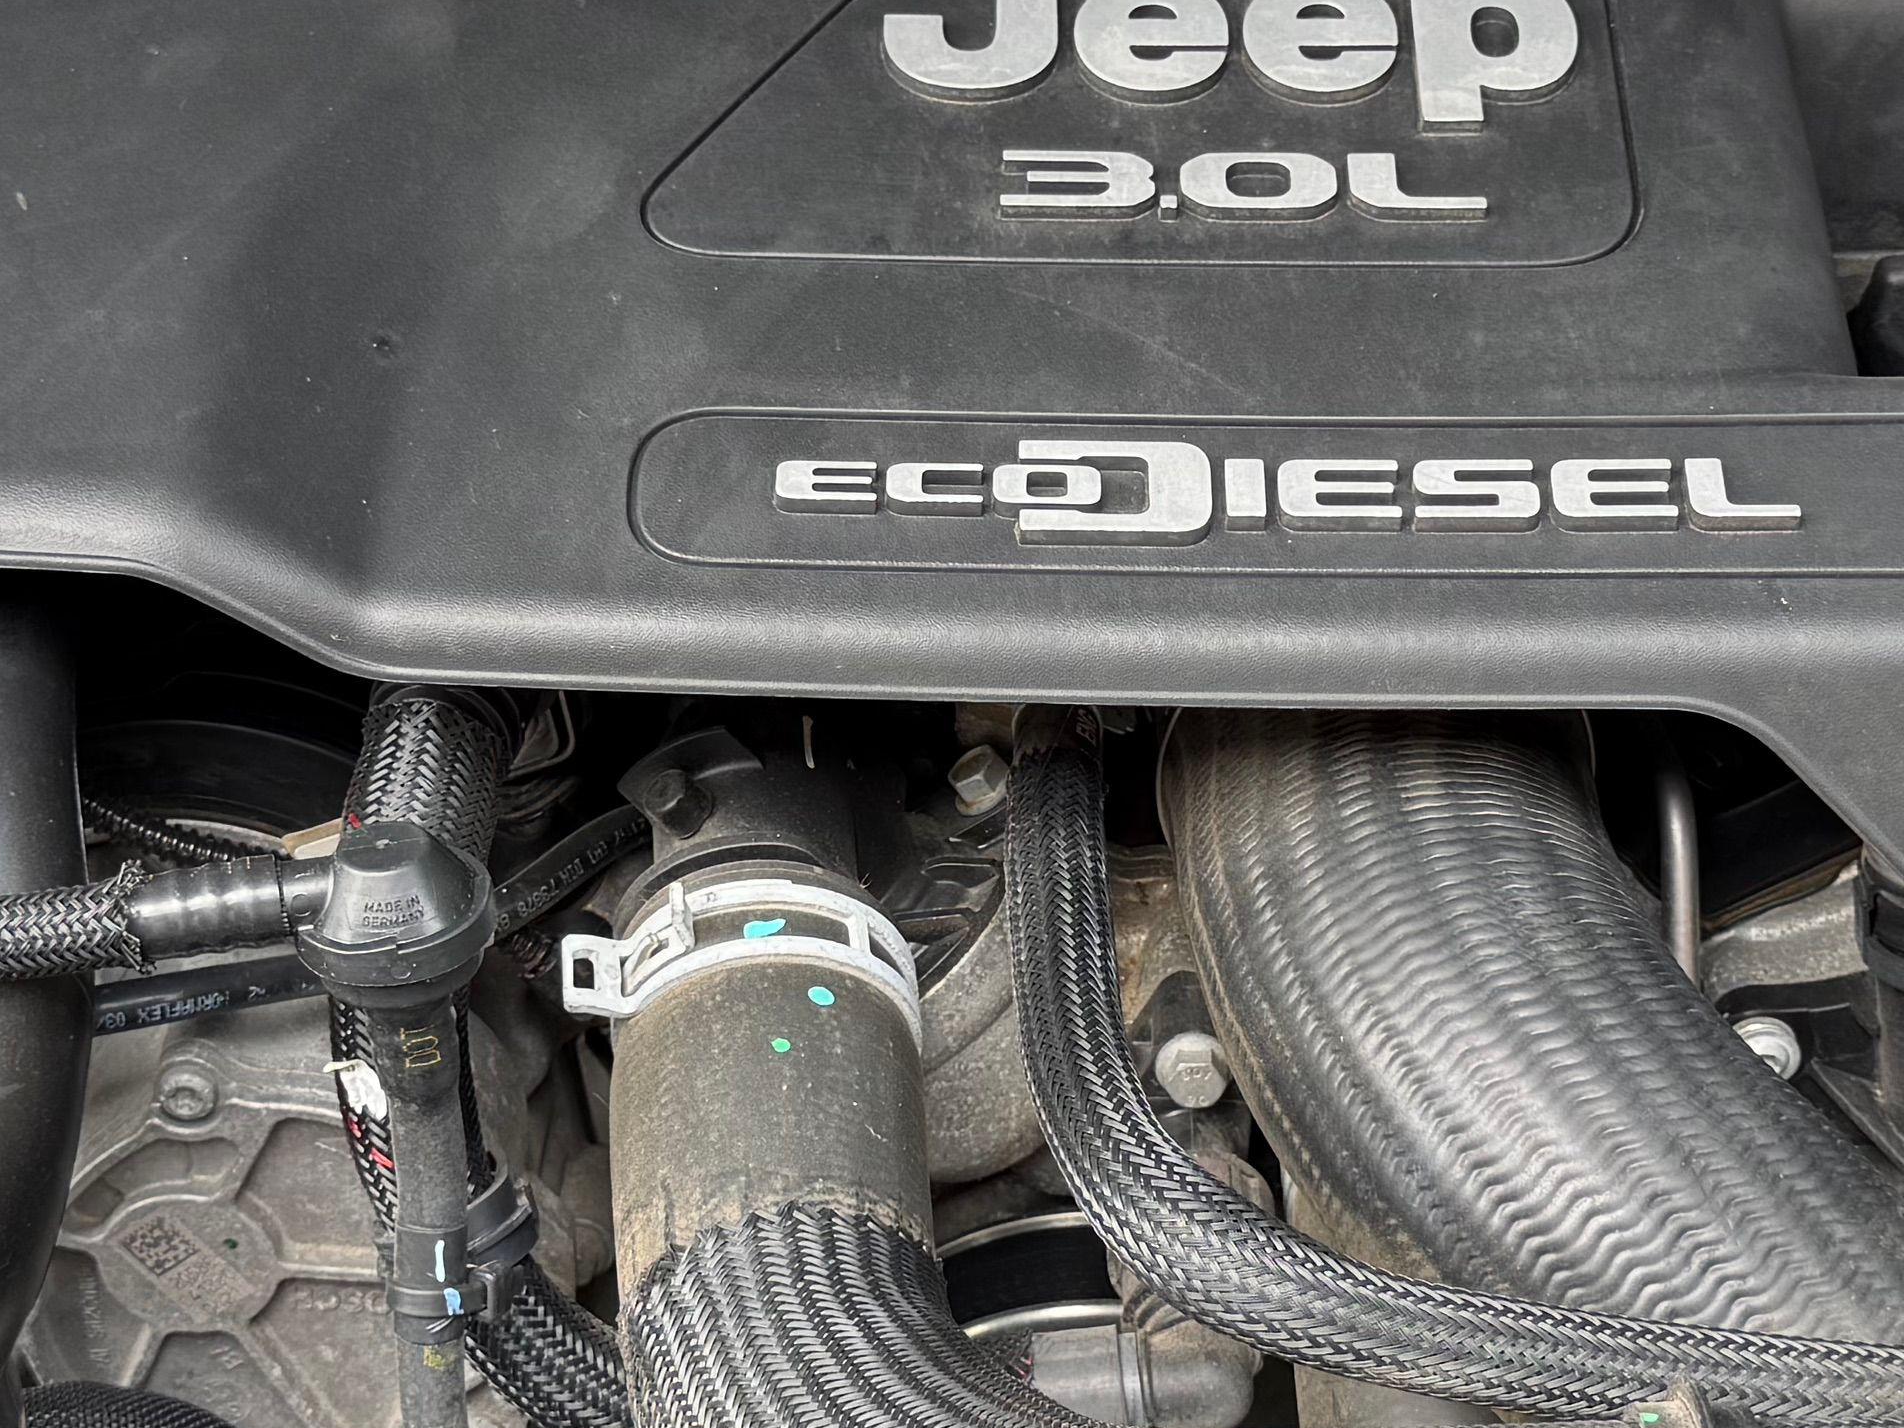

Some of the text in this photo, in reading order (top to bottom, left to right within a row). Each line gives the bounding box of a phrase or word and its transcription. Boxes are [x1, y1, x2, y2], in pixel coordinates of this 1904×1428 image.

[996, 149, 1491, 224] 3.0L
[364, 893, 421, 913] MADE IN
[362, 905, 425, 928] GERMANY
